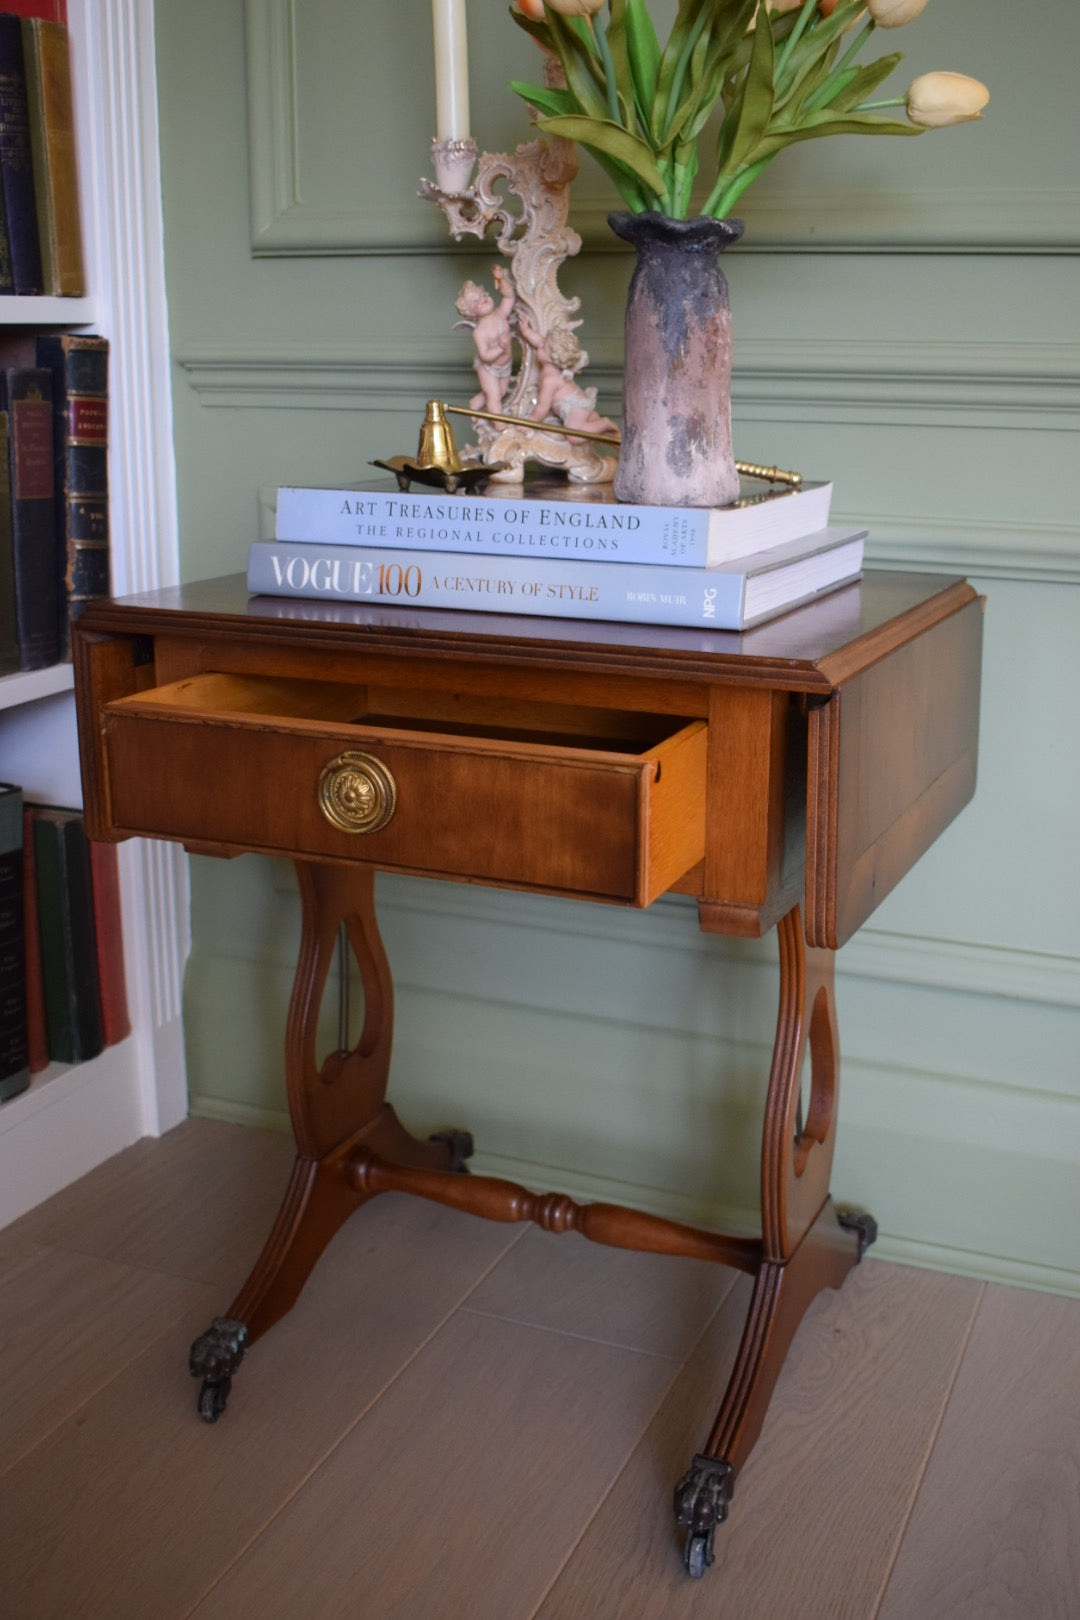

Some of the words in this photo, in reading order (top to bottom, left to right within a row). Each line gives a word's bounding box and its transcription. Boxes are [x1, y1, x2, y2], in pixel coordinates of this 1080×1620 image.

[340, 499, 378, 517] ART
[386, 500, 496, 523] TREASURES
[504, 509, 531, 525] OF
[540, 508, 641, 531] ENGLAND
[356, 524, 388, 537] THE
[395, 526, 484, 543] REGIONAL
[492, 531, 620, 551] COLLECTIONS
[662, 520, 670, 550] ROYAL
[671, 516, 680, 557] ACADEMY
[680, 543, 687, 555] OF
[269, 555, 373, 595] VOGUE
[375, 562, 422, 598] 100
[431, 575, 441, 590] A
[444, 576, 516, 596] CENTURY
[521, 579, 545, 597] OF
[546, 583, 599, 603] STYLE
[626, 591, 656, 604] ROBIN
[659, 593, 687, 606] MUIR
[703, 588, 717, 619] NPG
